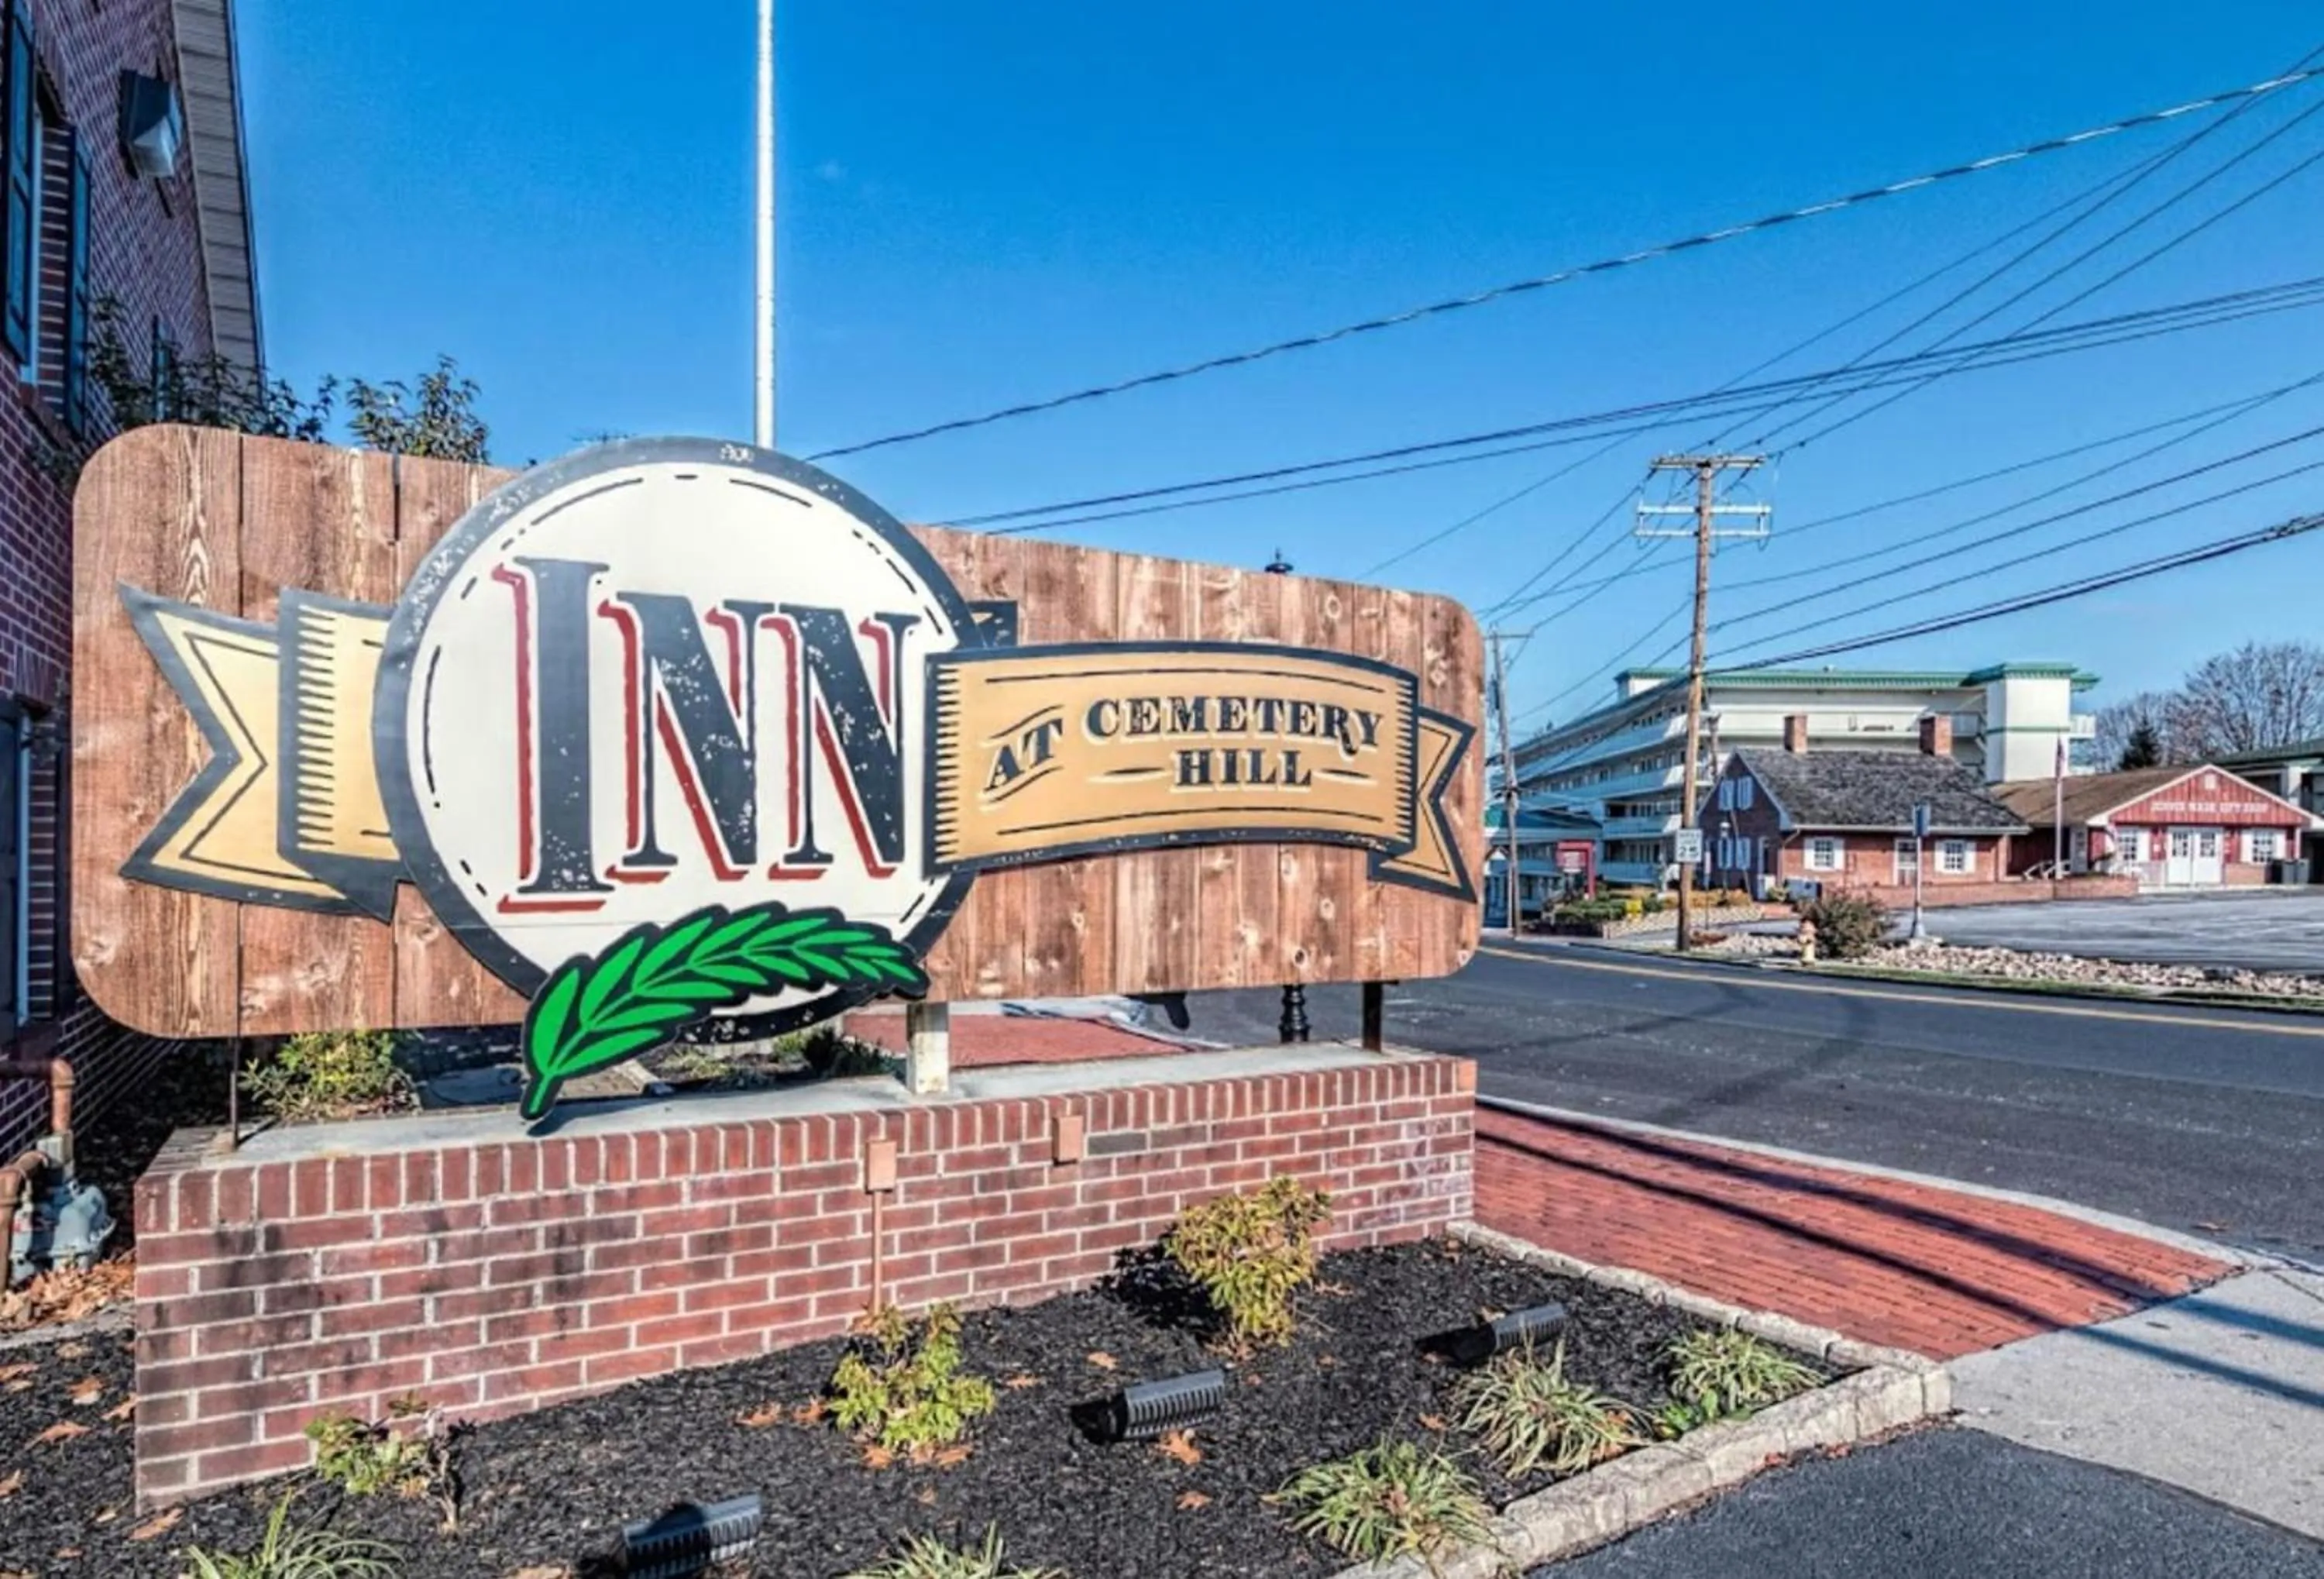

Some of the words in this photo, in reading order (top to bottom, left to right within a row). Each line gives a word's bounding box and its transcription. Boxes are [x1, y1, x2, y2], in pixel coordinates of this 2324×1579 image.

[493, 556, 922, 913] INN
[982, 717, 1064, 794] AT
[1083, 695, 1384, 756] CEMETERY
[1172, 747, 1313, 790] HILL
